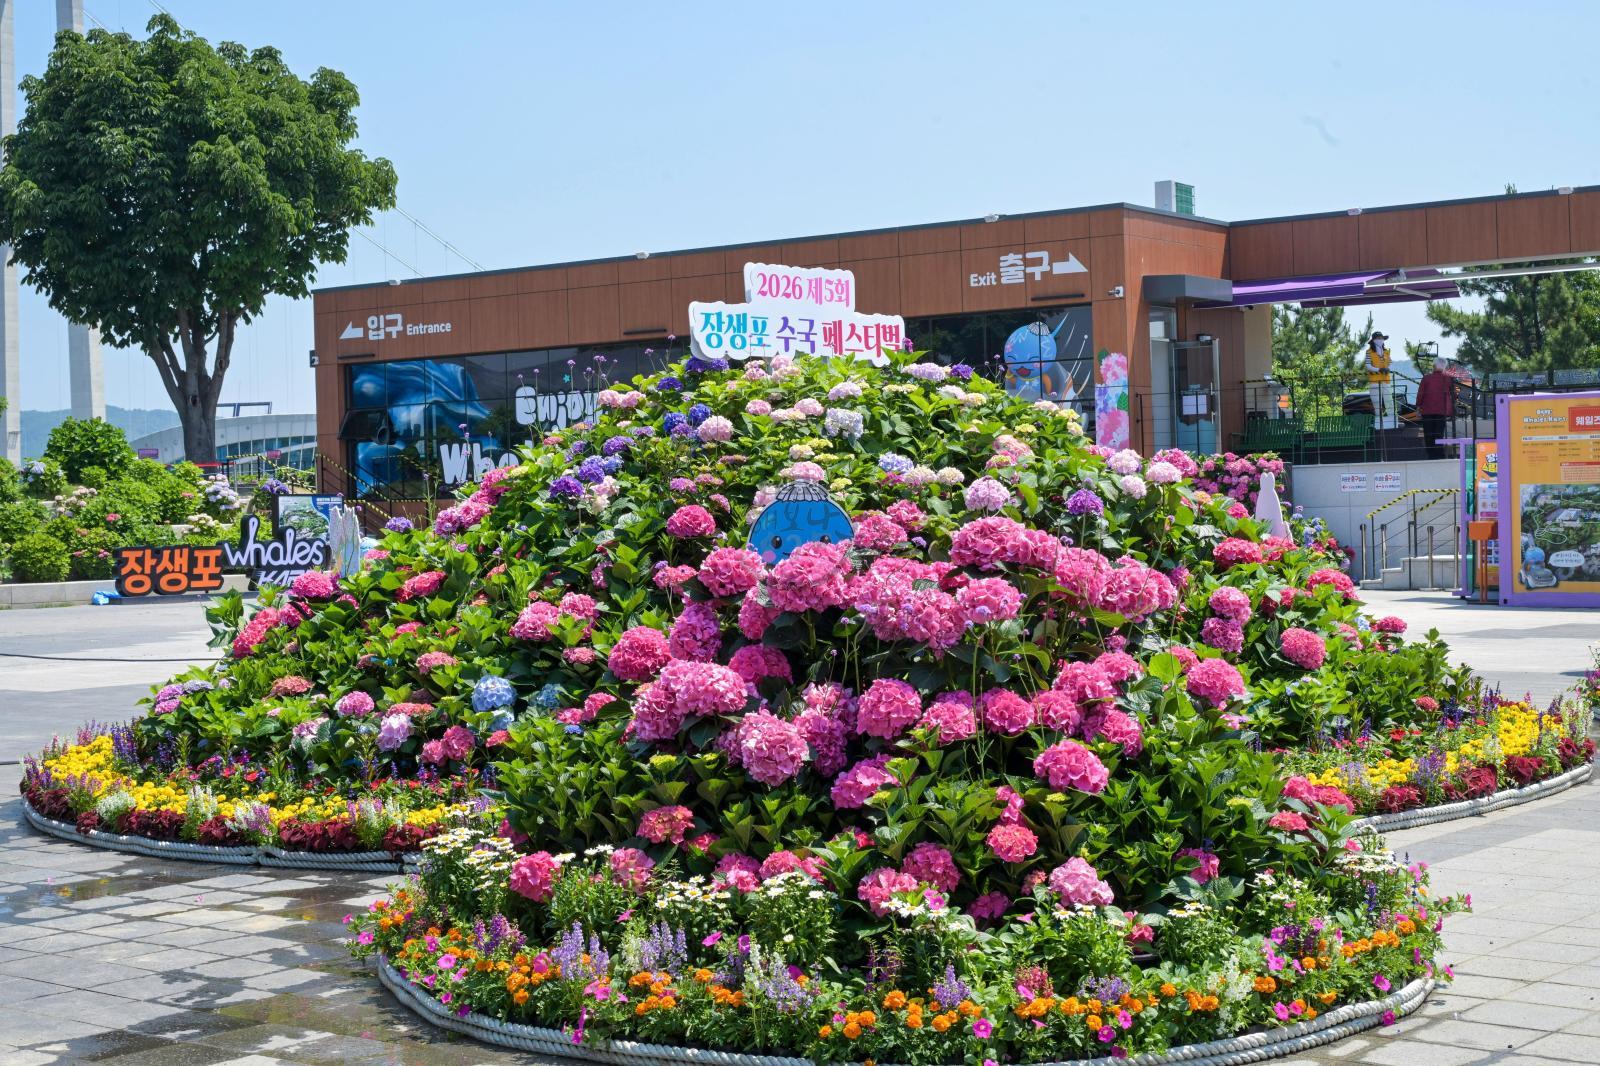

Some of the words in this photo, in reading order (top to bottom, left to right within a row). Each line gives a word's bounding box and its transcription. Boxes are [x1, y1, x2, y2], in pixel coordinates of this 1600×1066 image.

[969, 272, 997, 287] Exit
[999, 250, 1051, 285] 출구
[756, 272, 803, 300] 2026
[806, 276, 850, 308] 제5회
[367, 313, 404, 341] 입구
[406, 320, 452, 335] Entrance
[699, 311, 772, 351] 장생포
[776, 315, 818, 354] 수국
[821, 319, 901, 358] 페스티벌
[224, 516, 325, 567] whales
[120, 548, 223, 594] 장생포
